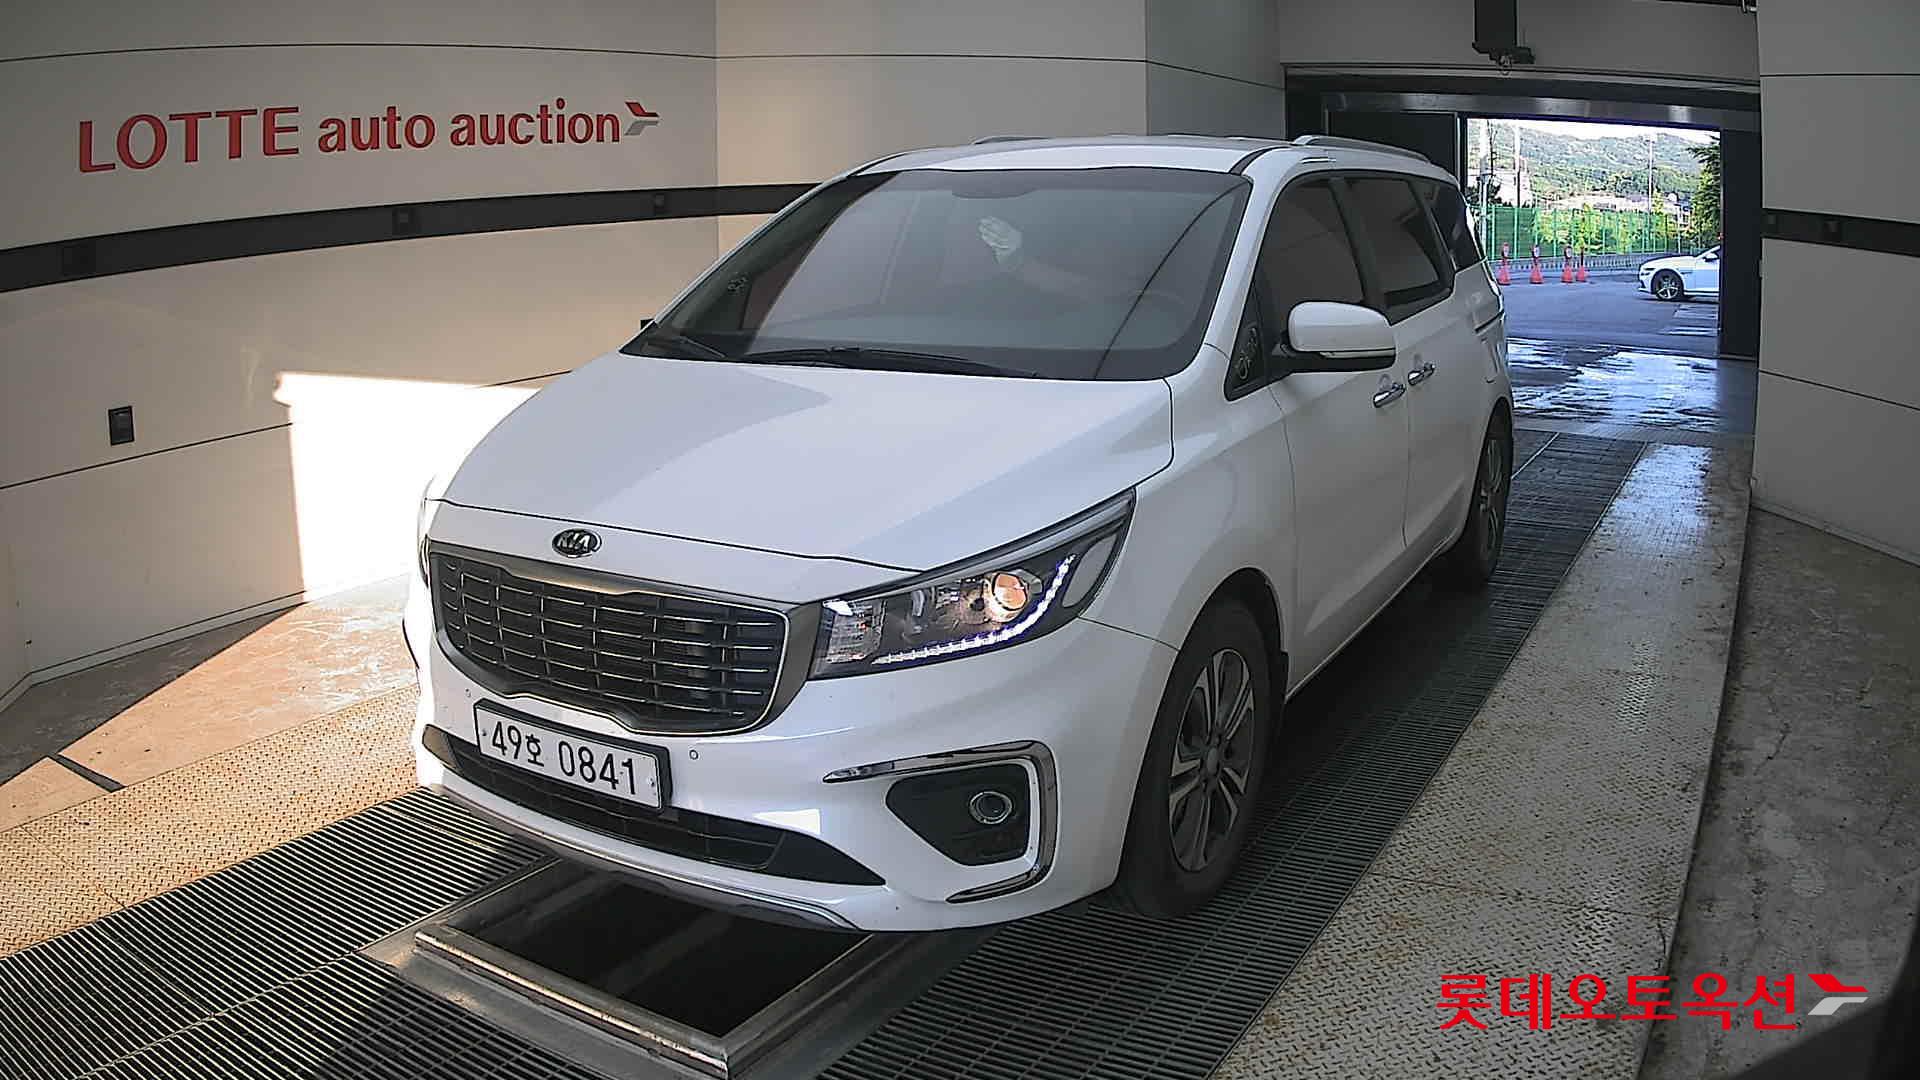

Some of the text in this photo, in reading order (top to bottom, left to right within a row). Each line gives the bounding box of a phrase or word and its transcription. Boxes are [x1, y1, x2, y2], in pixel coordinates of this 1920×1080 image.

[79, 98, 622, 173] LOTTE auto auction
[554, 530, 596, 553] KIA
[492, 721, 636, 795] 49호 0841
